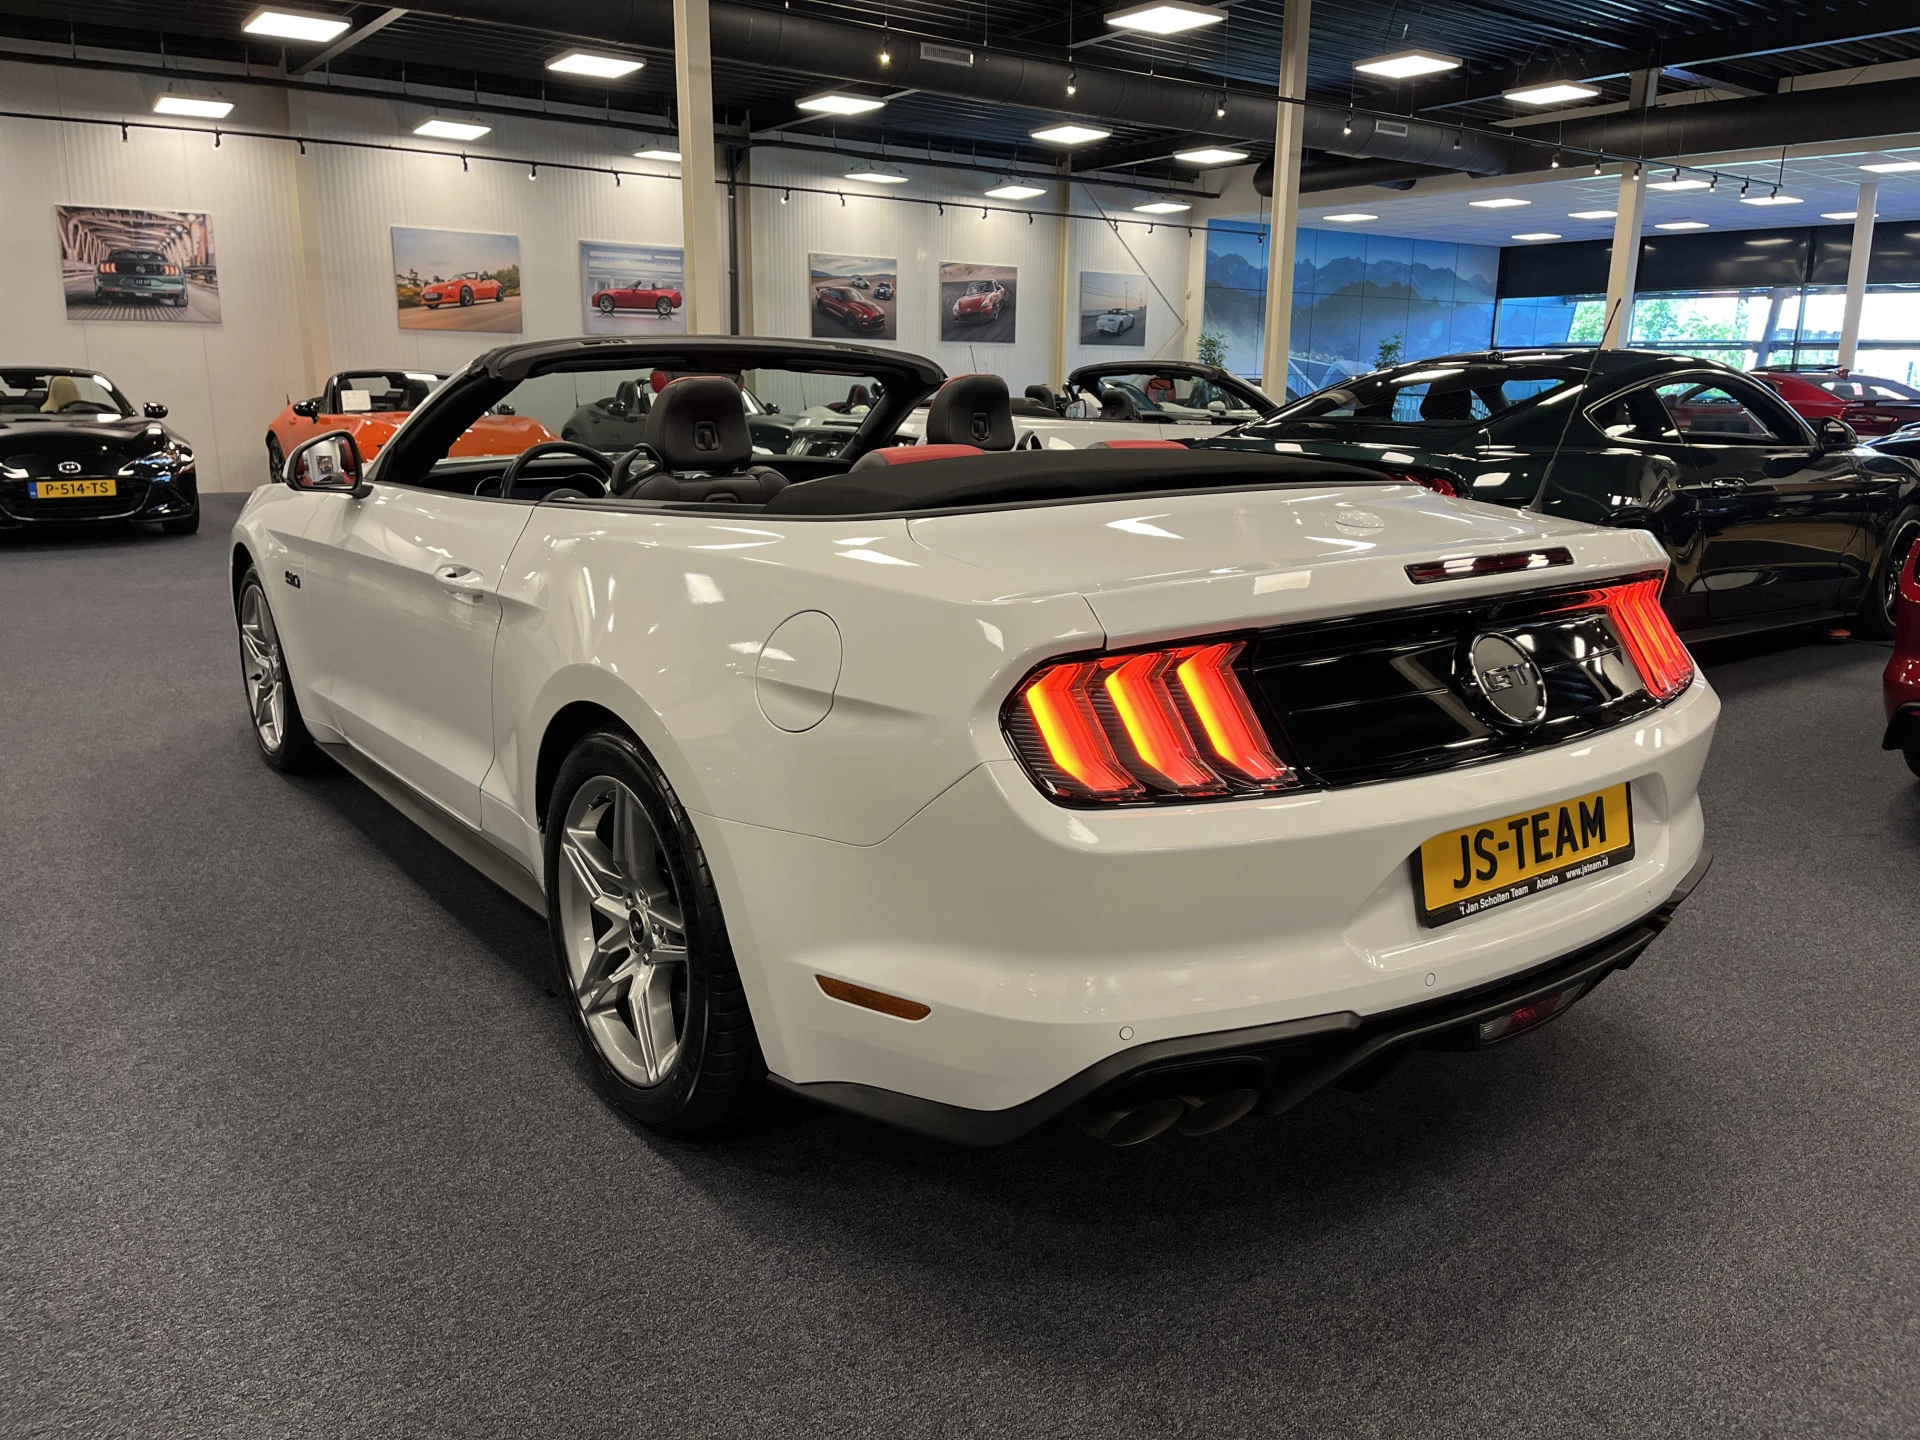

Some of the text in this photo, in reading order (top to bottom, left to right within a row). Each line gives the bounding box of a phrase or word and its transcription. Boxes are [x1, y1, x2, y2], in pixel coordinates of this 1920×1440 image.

[45, 482, 109, 496] P-514-TS
[1482, 663, 1530, 691] GT
[1453, 796, 1607, 890] JS-TEAM
[1466, 902, 1479, 914] Jan
[1480, 893, 1510, 908] Scholten
[1510, 885, 1528, 899] Team
[1536, 875, 1559, 889] Almelo
[1566, 857, 1608, 879] www.jsteam.nl
